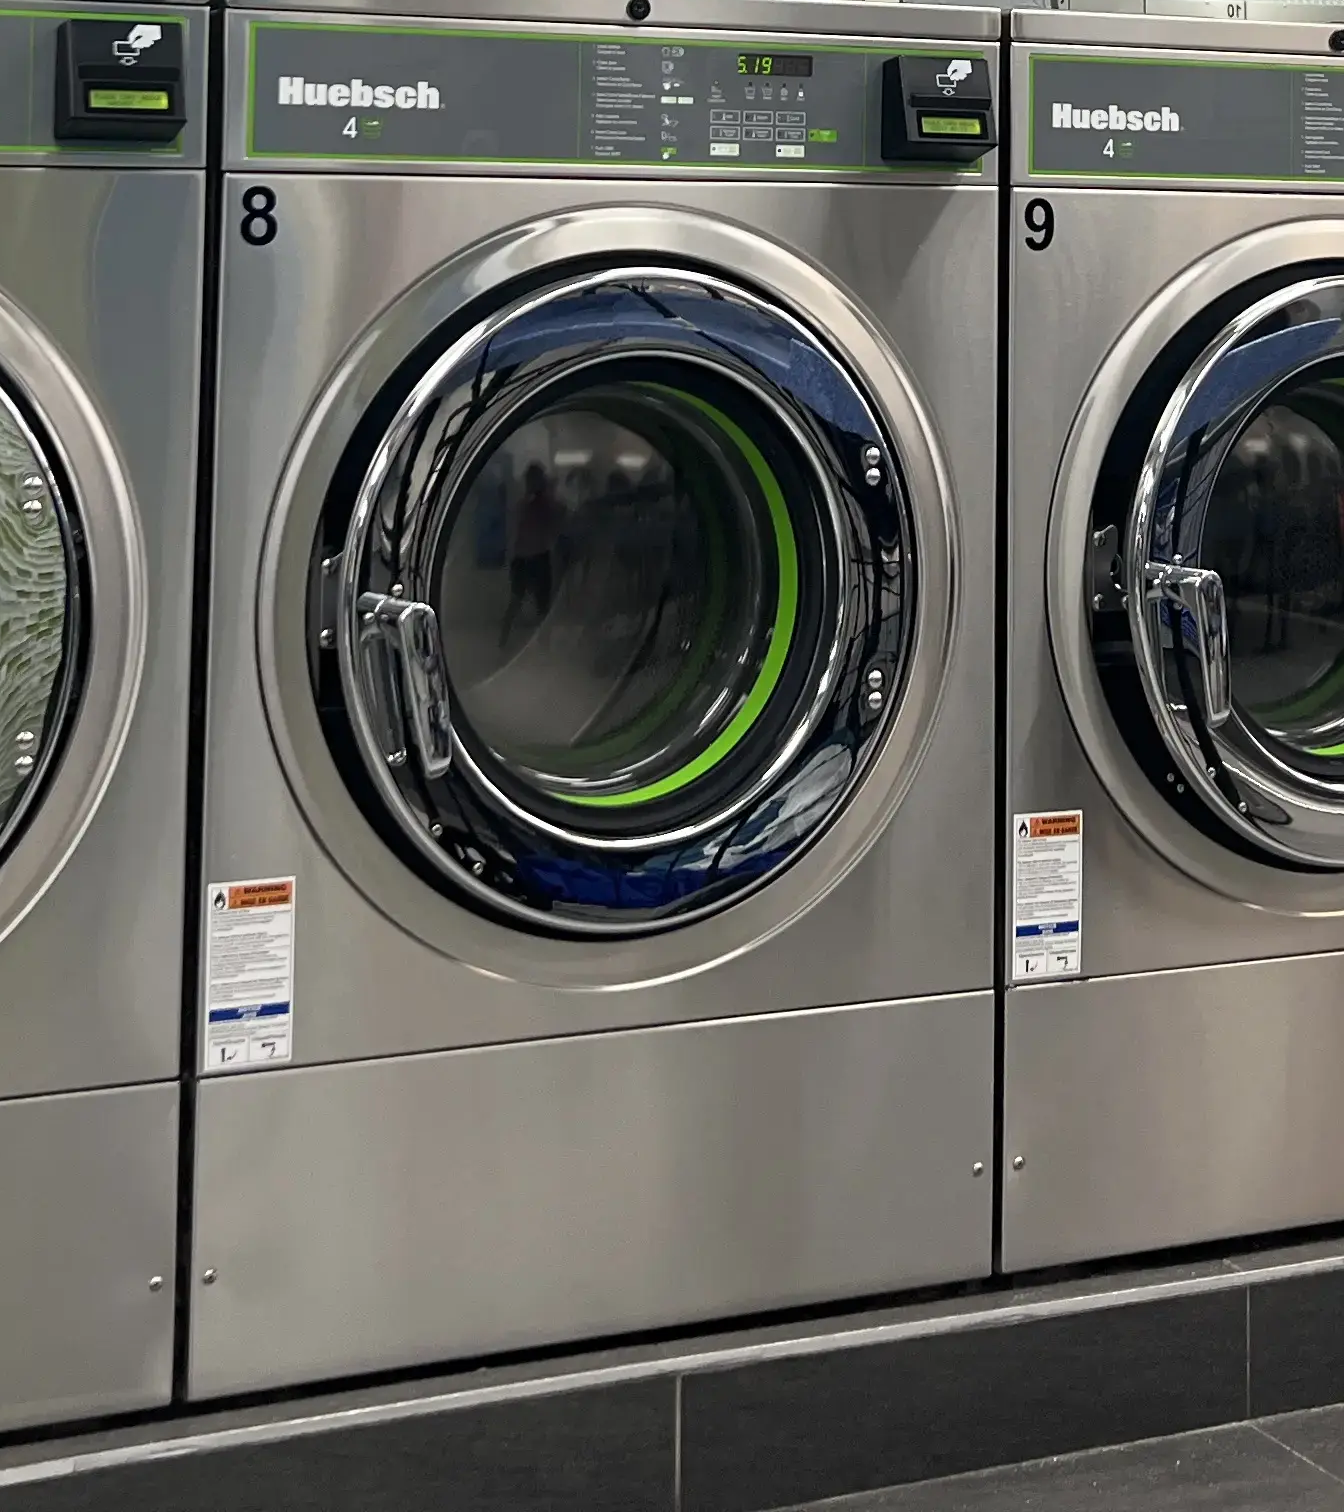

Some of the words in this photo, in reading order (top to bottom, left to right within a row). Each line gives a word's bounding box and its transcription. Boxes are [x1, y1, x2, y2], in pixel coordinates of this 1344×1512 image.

[737, 55, 773, 75] 5.19
[276, 75, 441, 110] Huebsch
[342, 115, 358, 139] 4
[1051, 102, 1181, 133] Huebsch
[1102, 138, 1115, 159] 4
[239, 186, 278, 247] 8
[1023, 197, 1056, 251] 9
